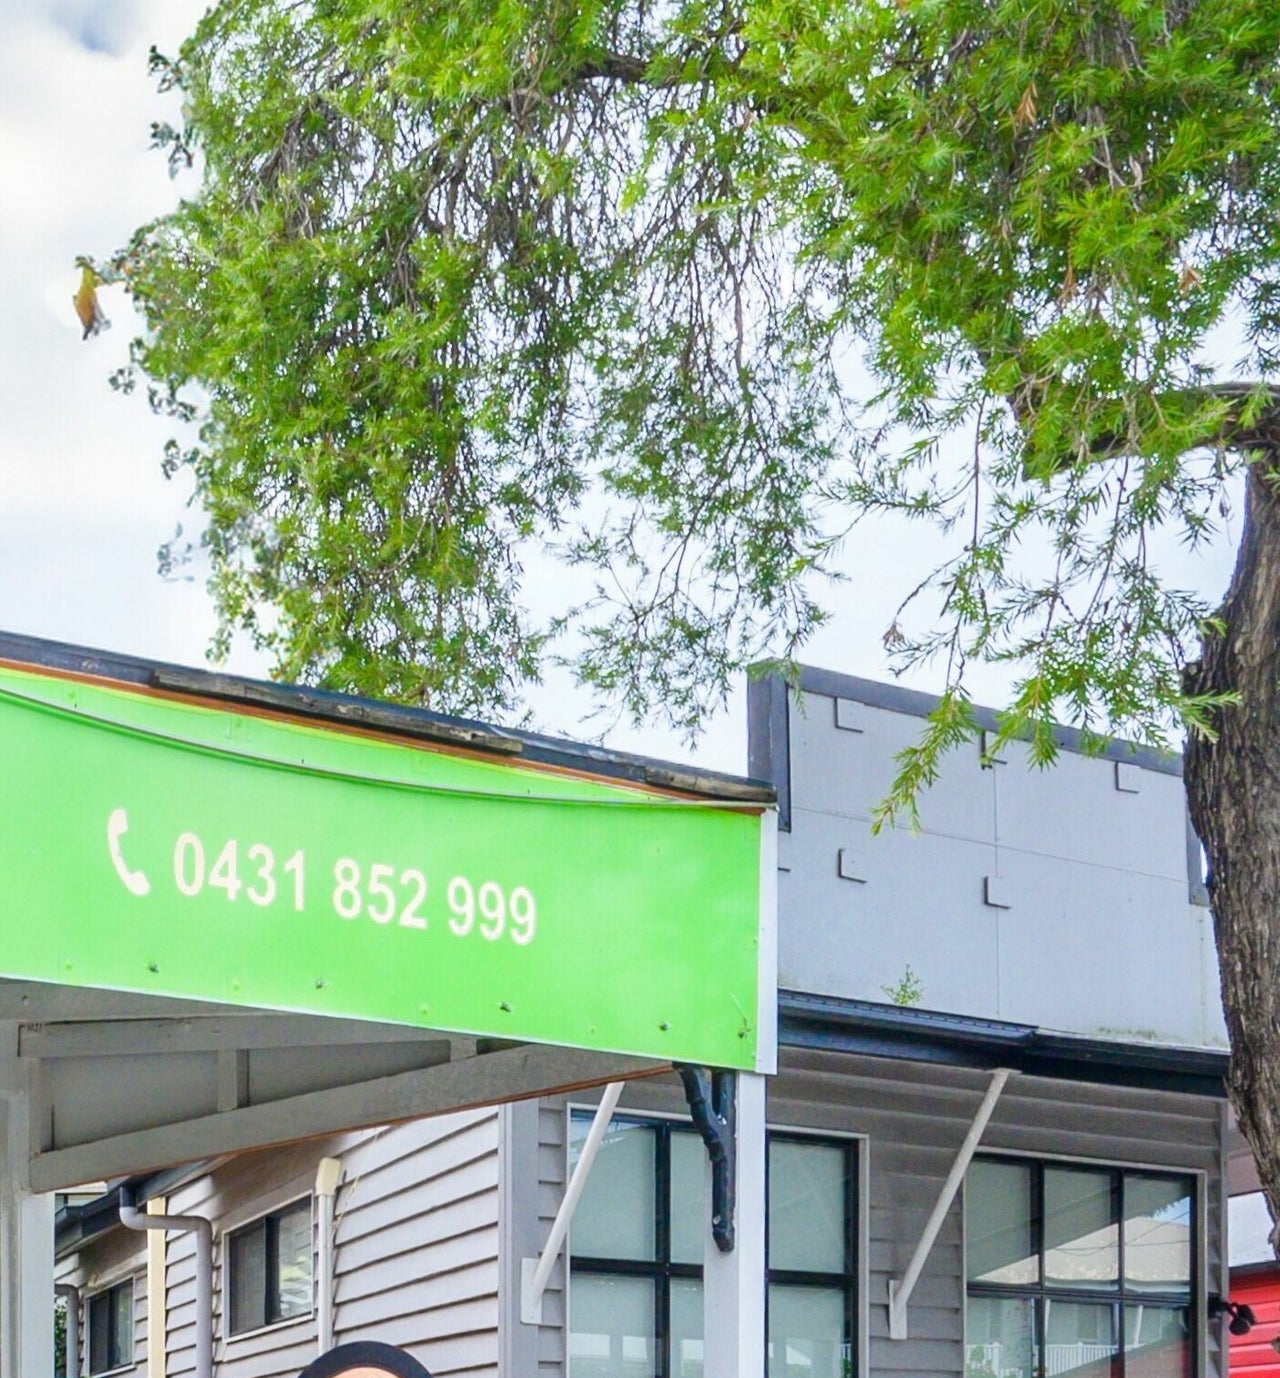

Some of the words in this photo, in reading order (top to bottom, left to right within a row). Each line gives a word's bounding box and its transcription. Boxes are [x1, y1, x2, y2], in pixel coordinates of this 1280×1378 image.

[173, 832, 306, 912] 0431
[332, 858, 428, 930] 852
[446, 875, 537, 946] 999
